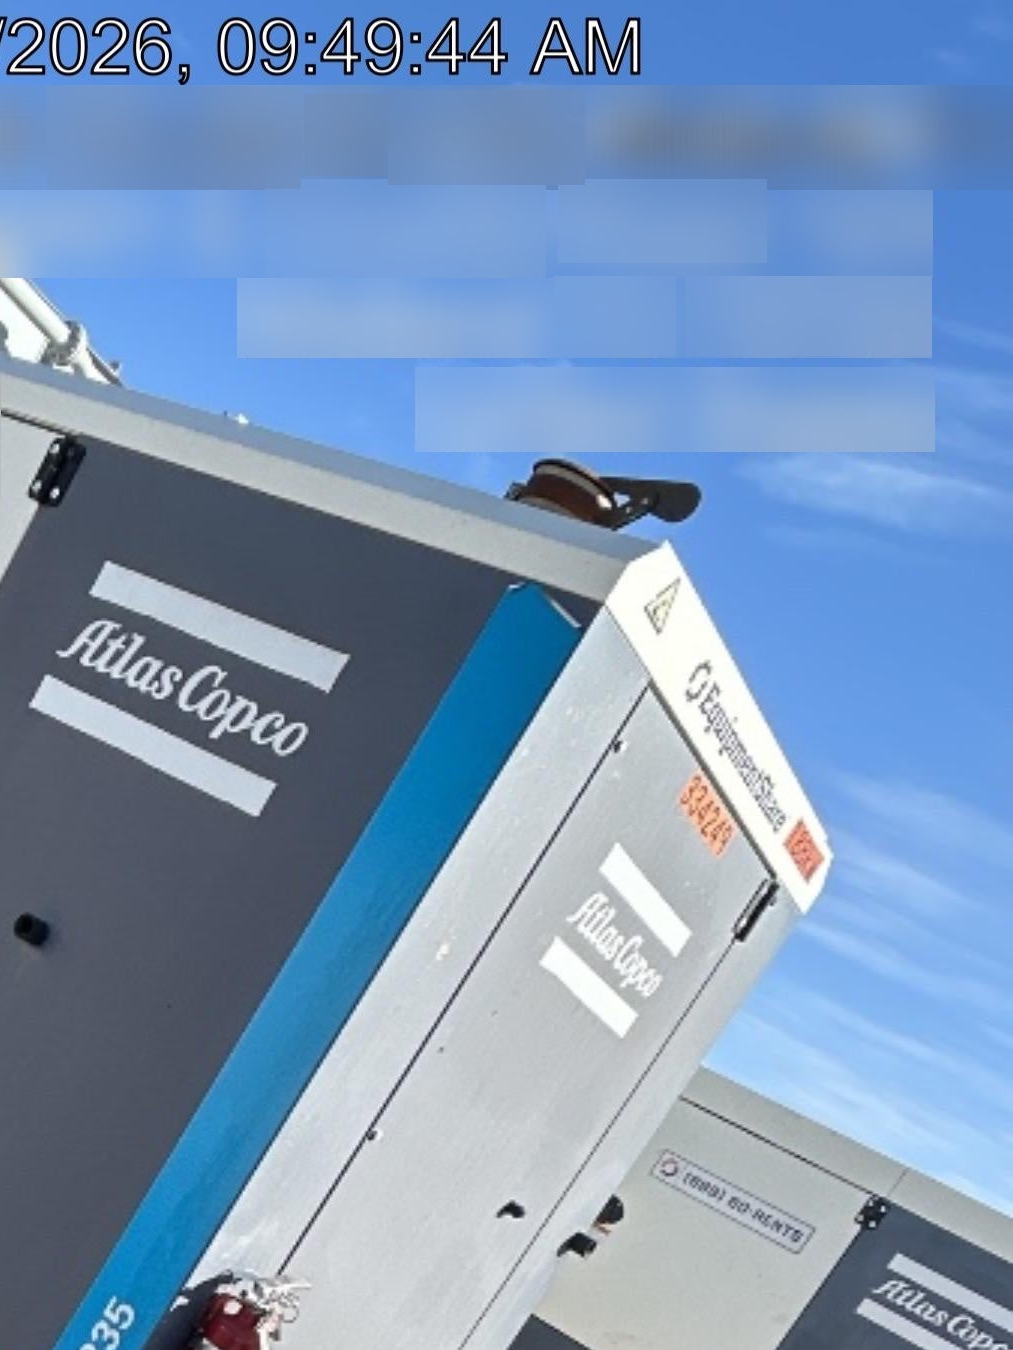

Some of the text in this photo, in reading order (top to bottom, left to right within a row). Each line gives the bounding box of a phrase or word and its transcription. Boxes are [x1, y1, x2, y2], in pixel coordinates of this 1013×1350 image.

[55, 618, 309, 757] Atlas Copco
[565, 890, 663, 998] Atlas Copco
[871, 1279, 949, 1327] Atlas
